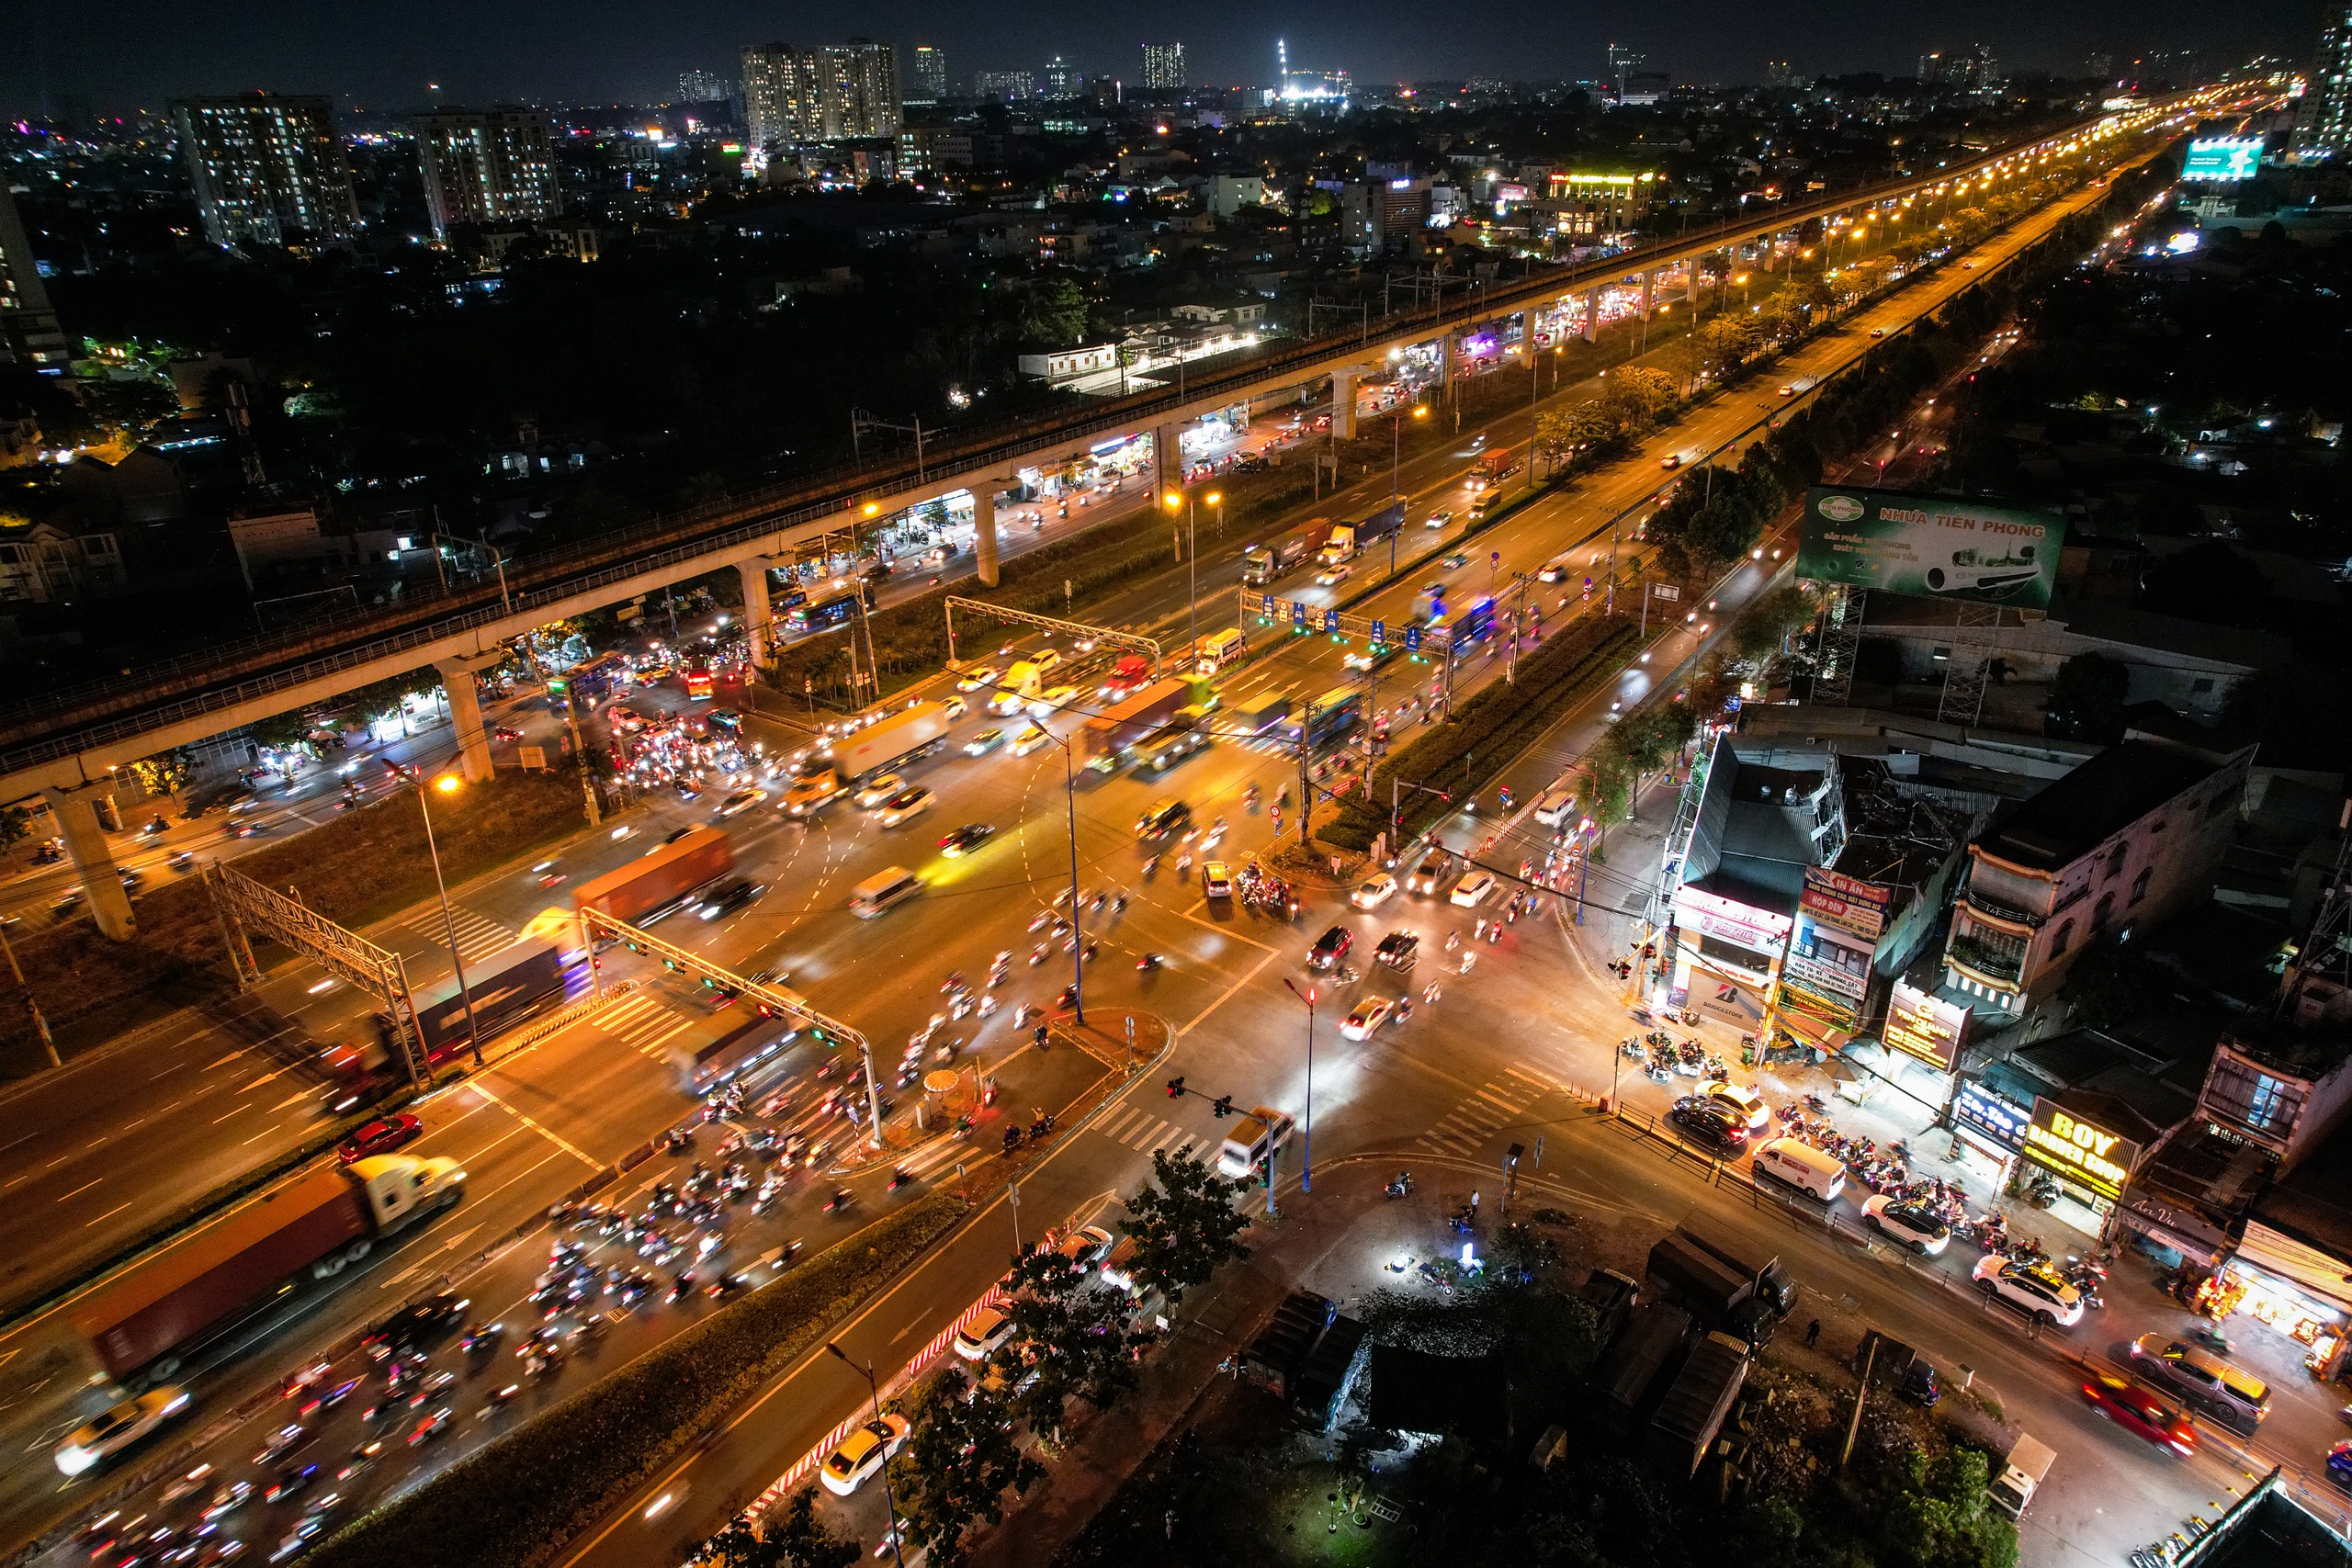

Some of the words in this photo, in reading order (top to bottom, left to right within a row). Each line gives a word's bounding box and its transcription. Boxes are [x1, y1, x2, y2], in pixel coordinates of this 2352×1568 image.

[1879, 507, 1928, 526] NHỰA
[1936, 513, 1975, 530] TIỀN
[1982, 520, 2046, 538] PHONG
[1883, 540, 1911, 550] PHONG
[1836, 879, 1848, 890] IN
[1849, 879, 1864, 896] ẤN
[1811, 894, 1828, 909] HỘP
[1827, 899, 1843, 914] ĐÈN
[1702, 1001, 1744, 1020] BRIDGESTONE
[2052, 1111, 2116, 1157] BOY
[2028, 1123, 2085, 1165] BARBER
[2084, 1152, 2127, 1183] SHOP
[2132, 1200, 2155, 1216] An
